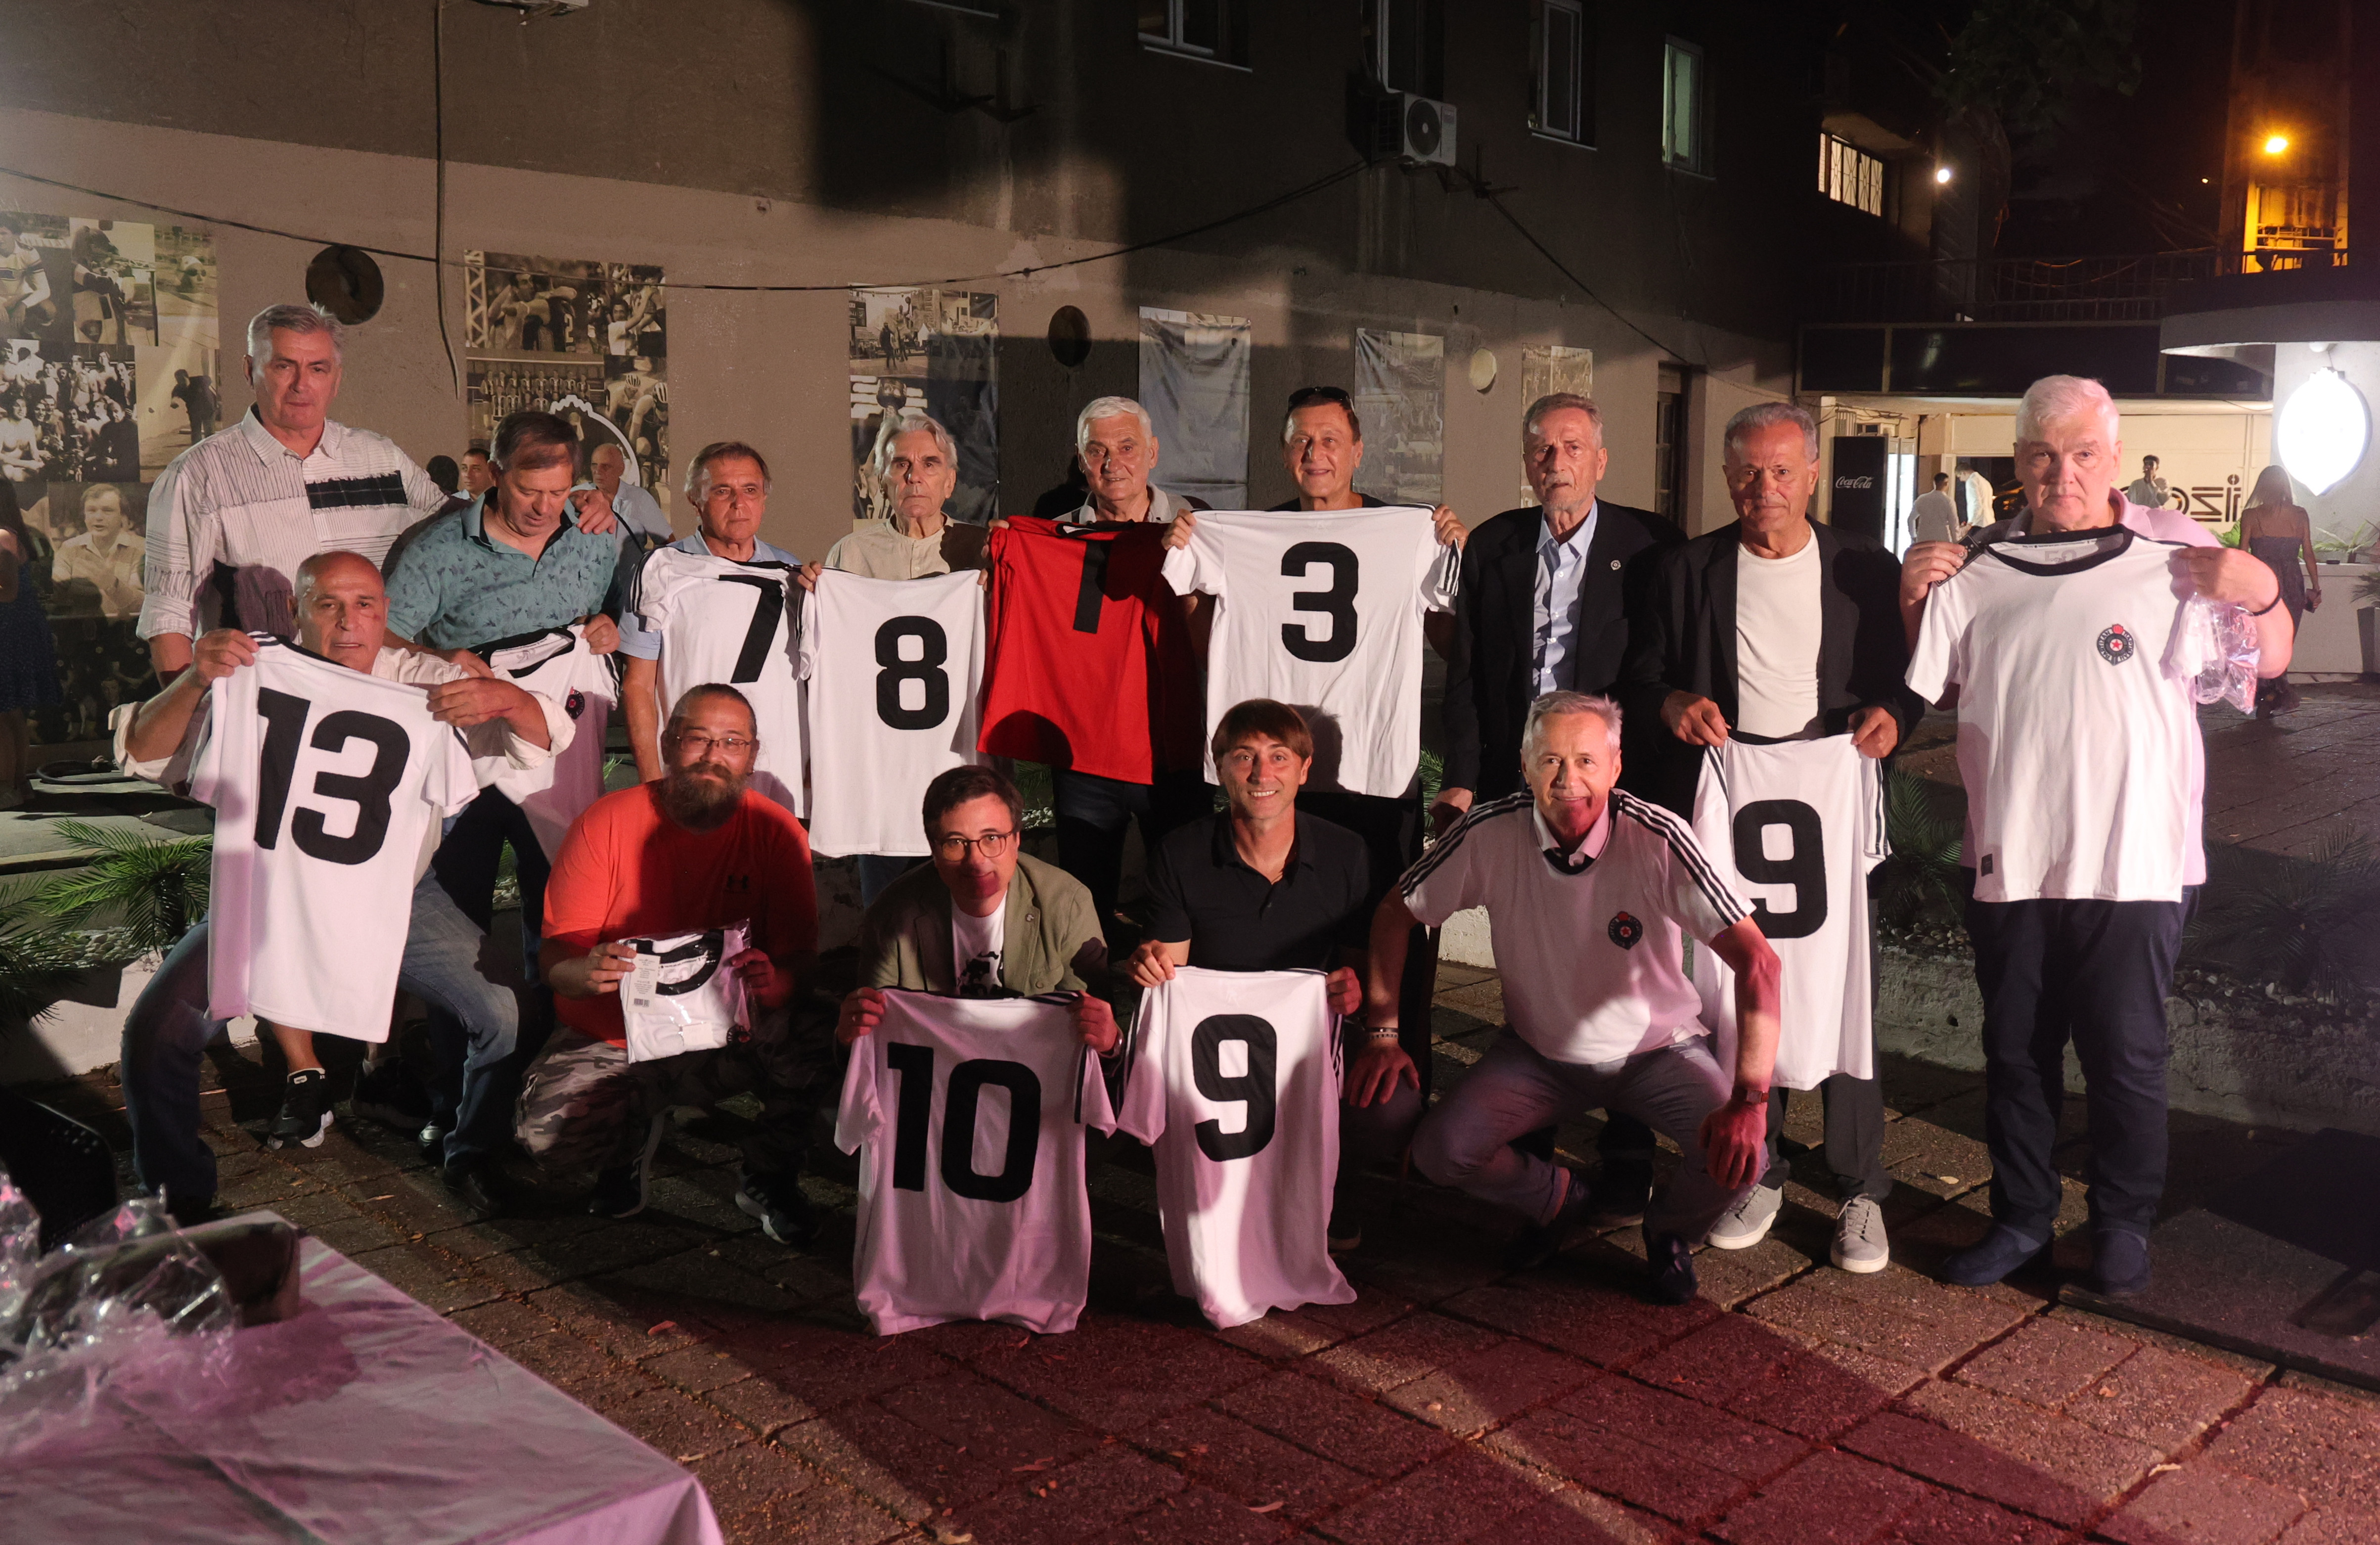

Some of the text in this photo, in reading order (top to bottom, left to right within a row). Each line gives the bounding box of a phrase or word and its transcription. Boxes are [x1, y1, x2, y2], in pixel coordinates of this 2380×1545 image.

[718, 575, 784, 683] 7
[874, 615, 950, 730] 8
[1281, 542, 1358, 663] 3
[254, 686, 410, 865] 13
[1733, 799, 1828, 939] 9
[887, 1041, 1041, 1203] 10
[1192, 1014, 1277, 1162] 9
